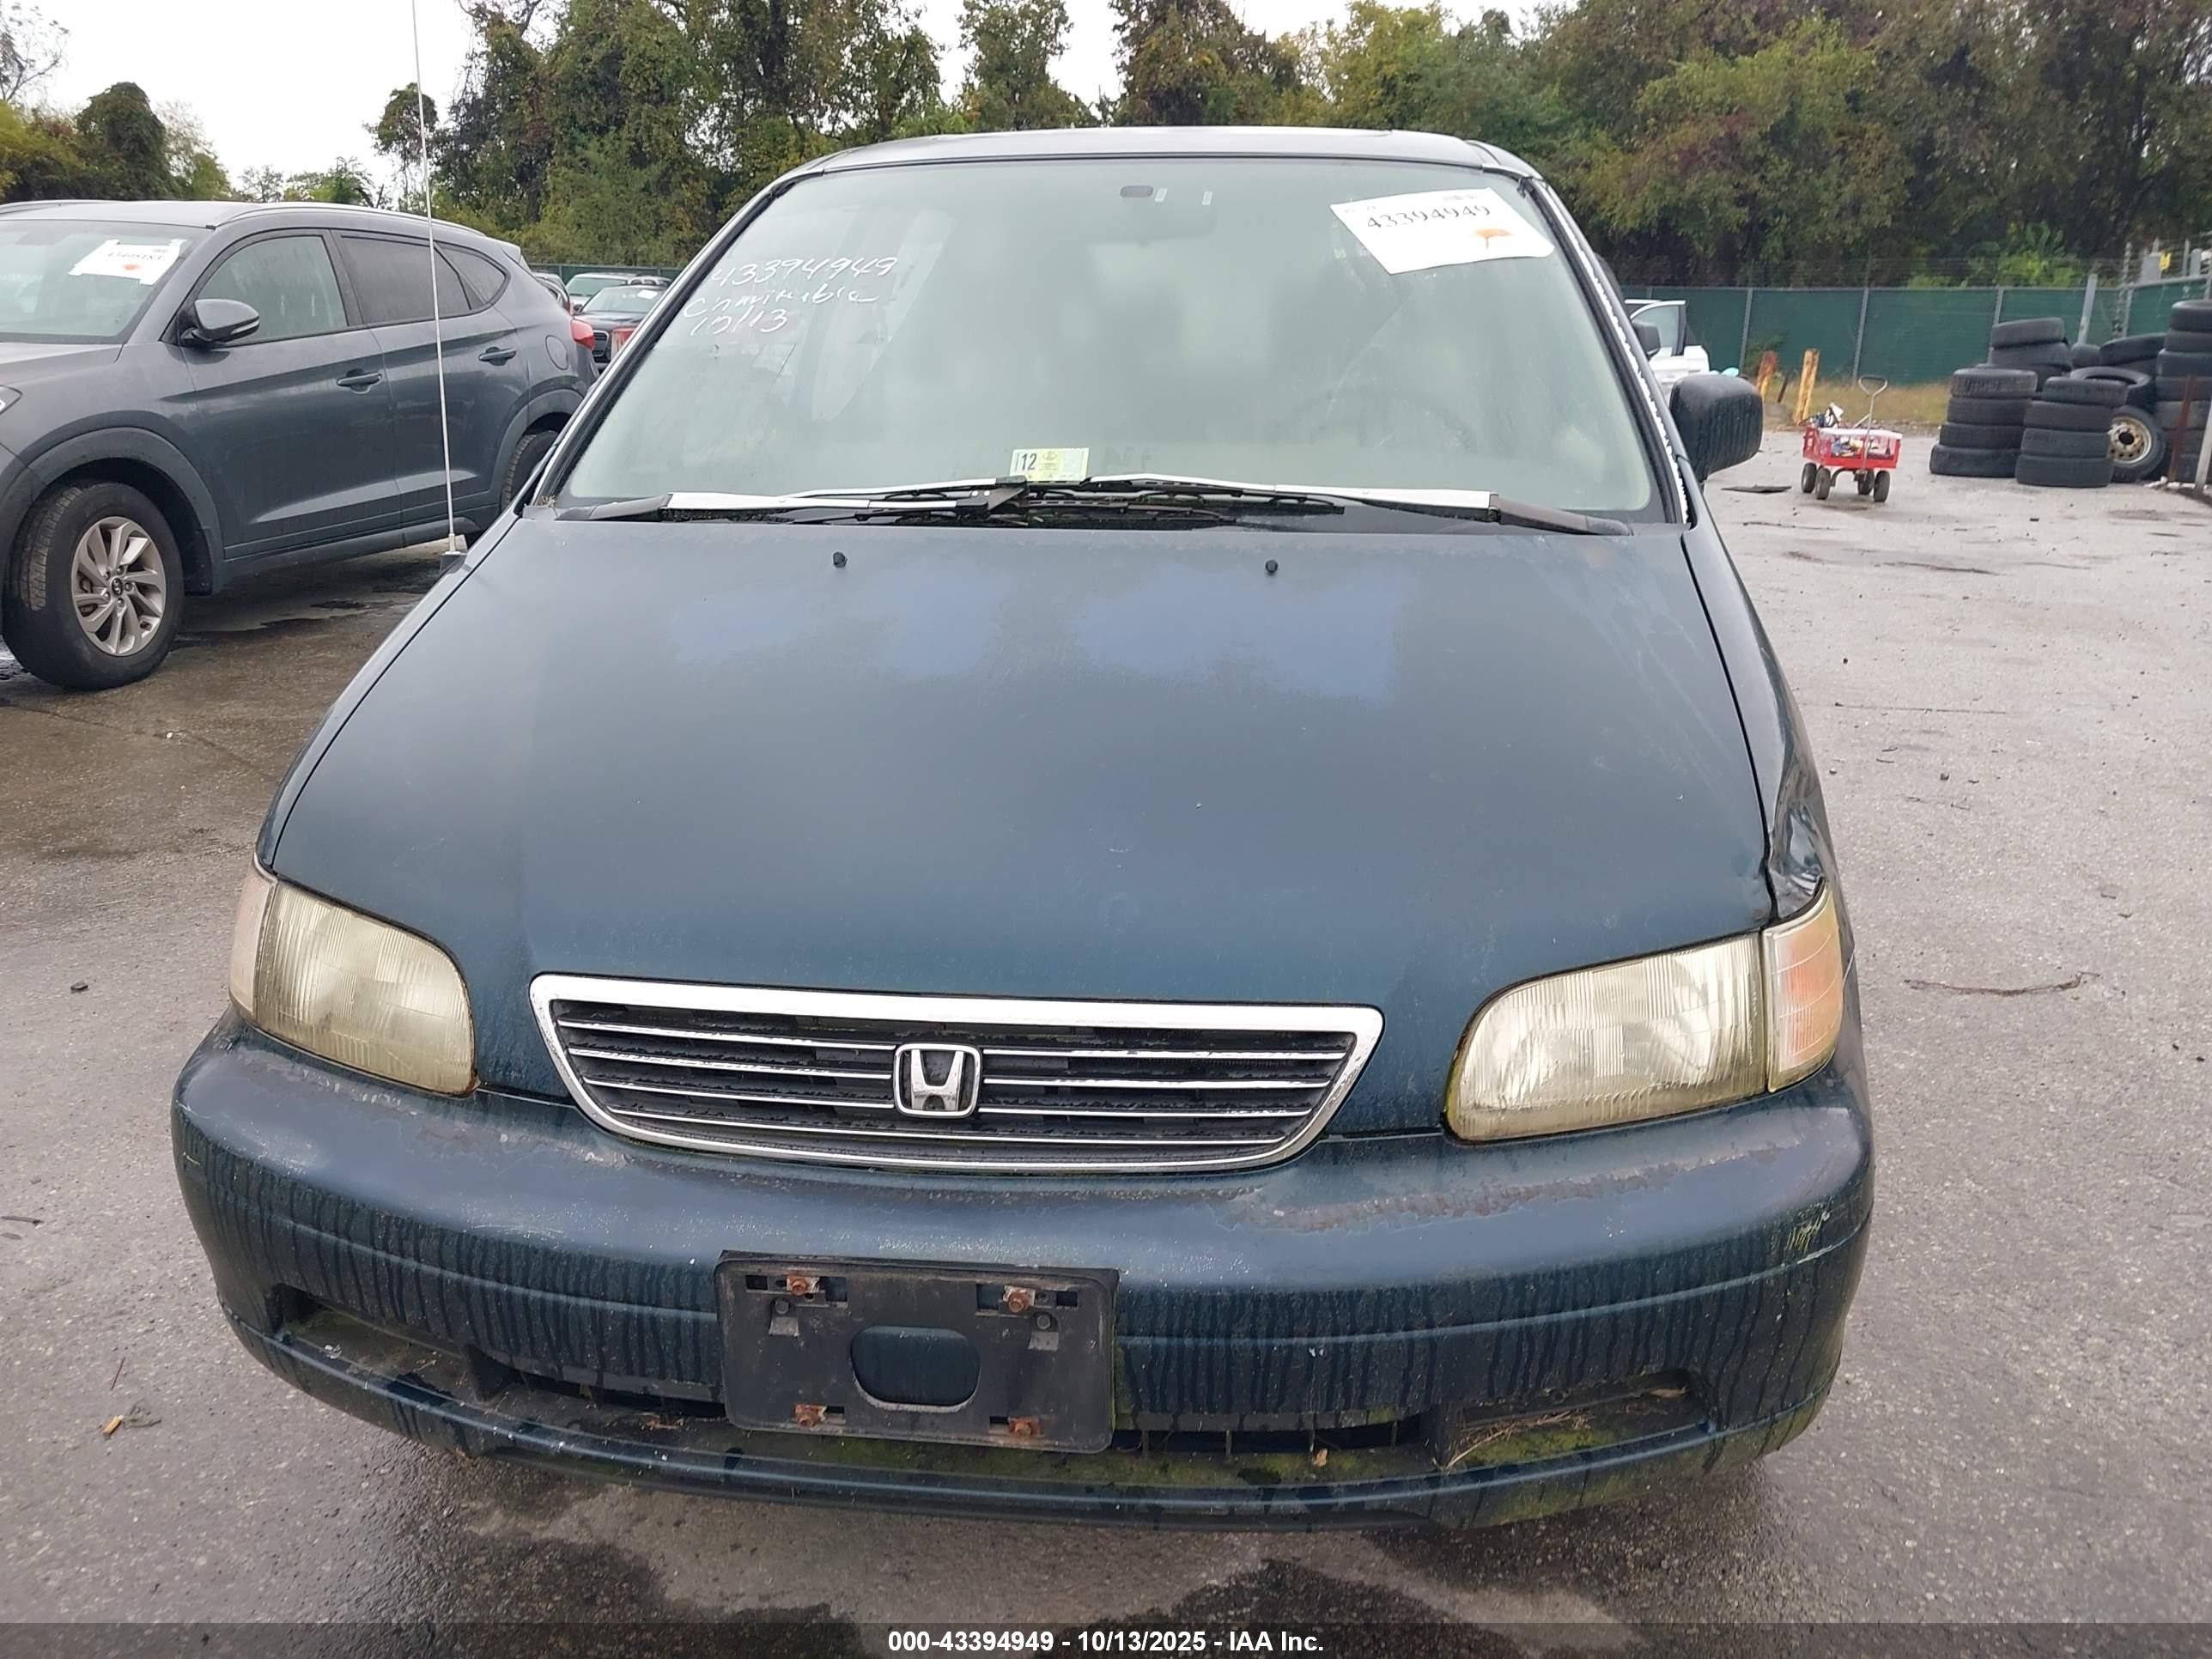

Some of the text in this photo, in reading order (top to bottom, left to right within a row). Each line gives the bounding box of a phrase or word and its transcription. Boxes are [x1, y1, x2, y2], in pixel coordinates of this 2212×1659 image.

[1367, 205, 1491, 228] 43394949
[711, 257, 898, 287] 43394949
[1021, 453, 1037, 471] 12
